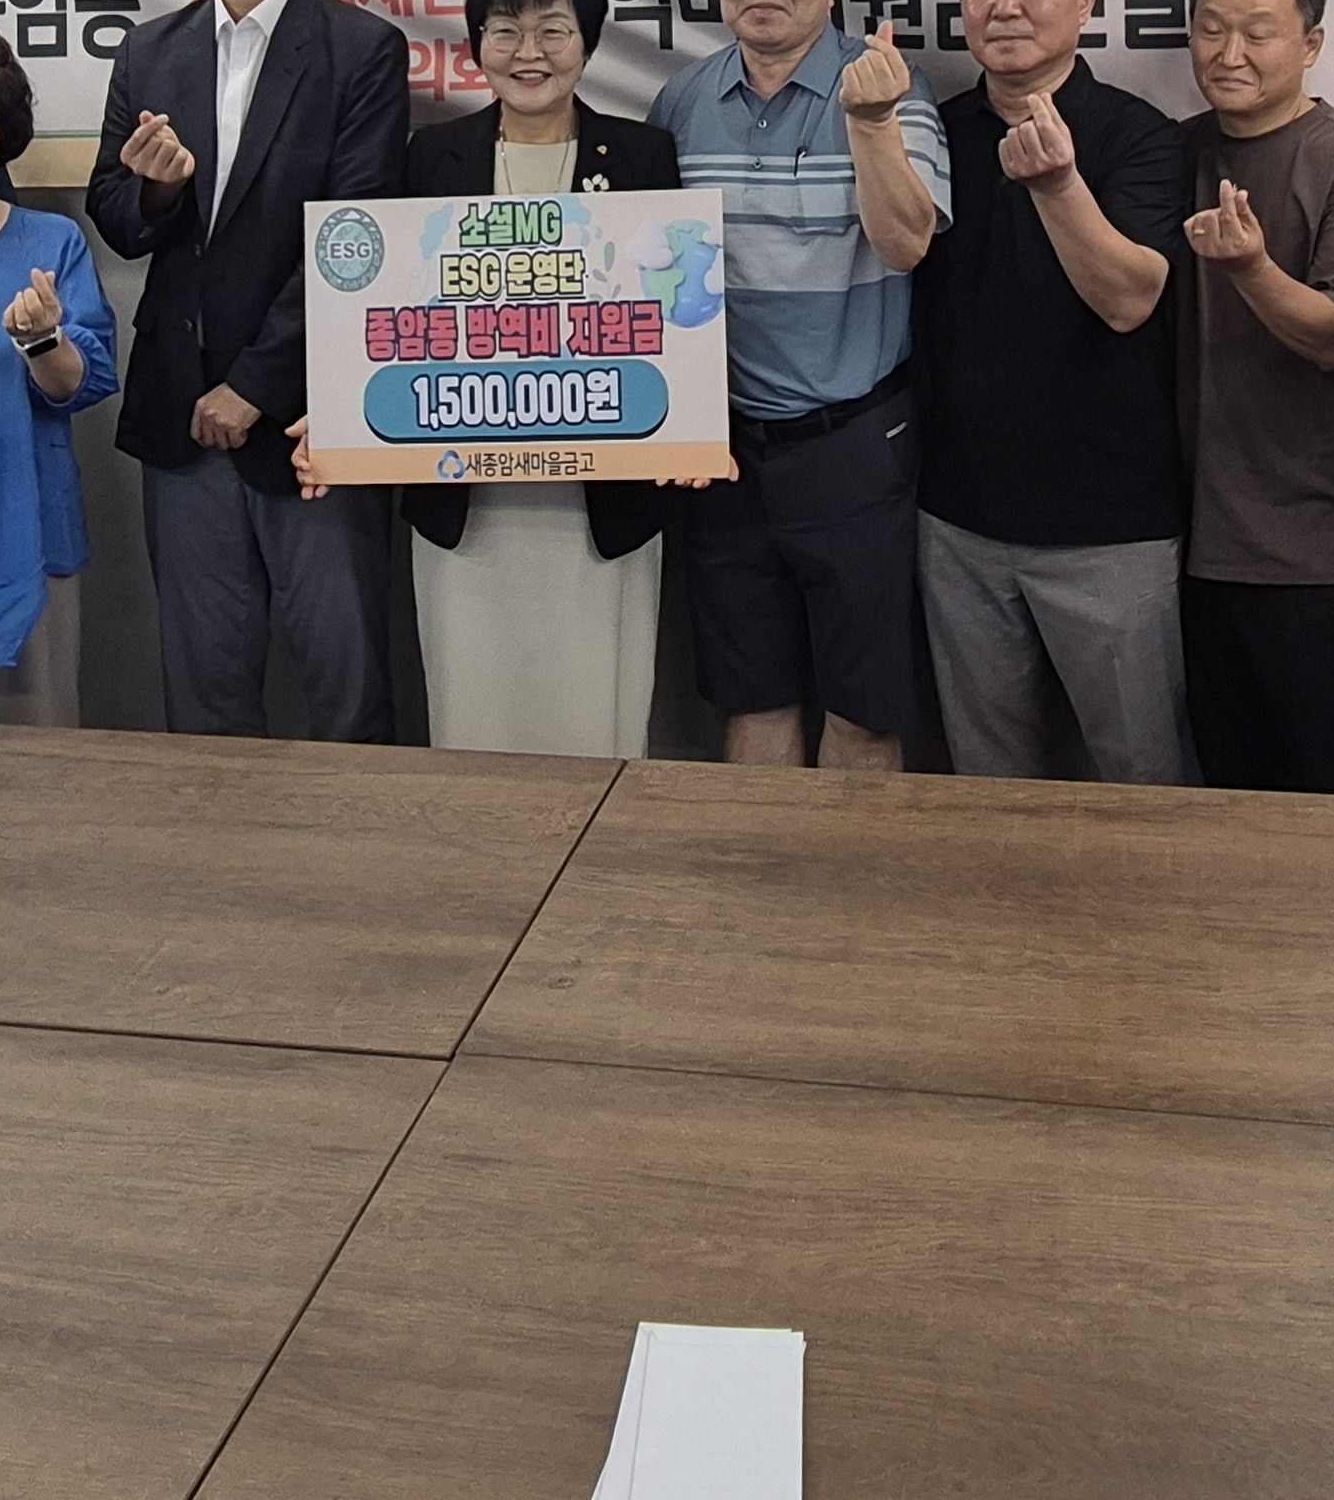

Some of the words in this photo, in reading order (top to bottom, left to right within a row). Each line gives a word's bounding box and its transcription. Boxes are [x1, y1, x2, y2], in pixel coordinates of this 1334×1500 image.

[329, 240, 372, 260] ESG
[505, 248, 586, 297] 운영단
[366, 304, 459, 362] 종암동
[466, 302, 561, 358] 방역비
[566, 299, 664, 357] 지원금
[411, 368, 623, 430] 1,500,000원
[465, 450, 596, 478] 새종암새마을금고
